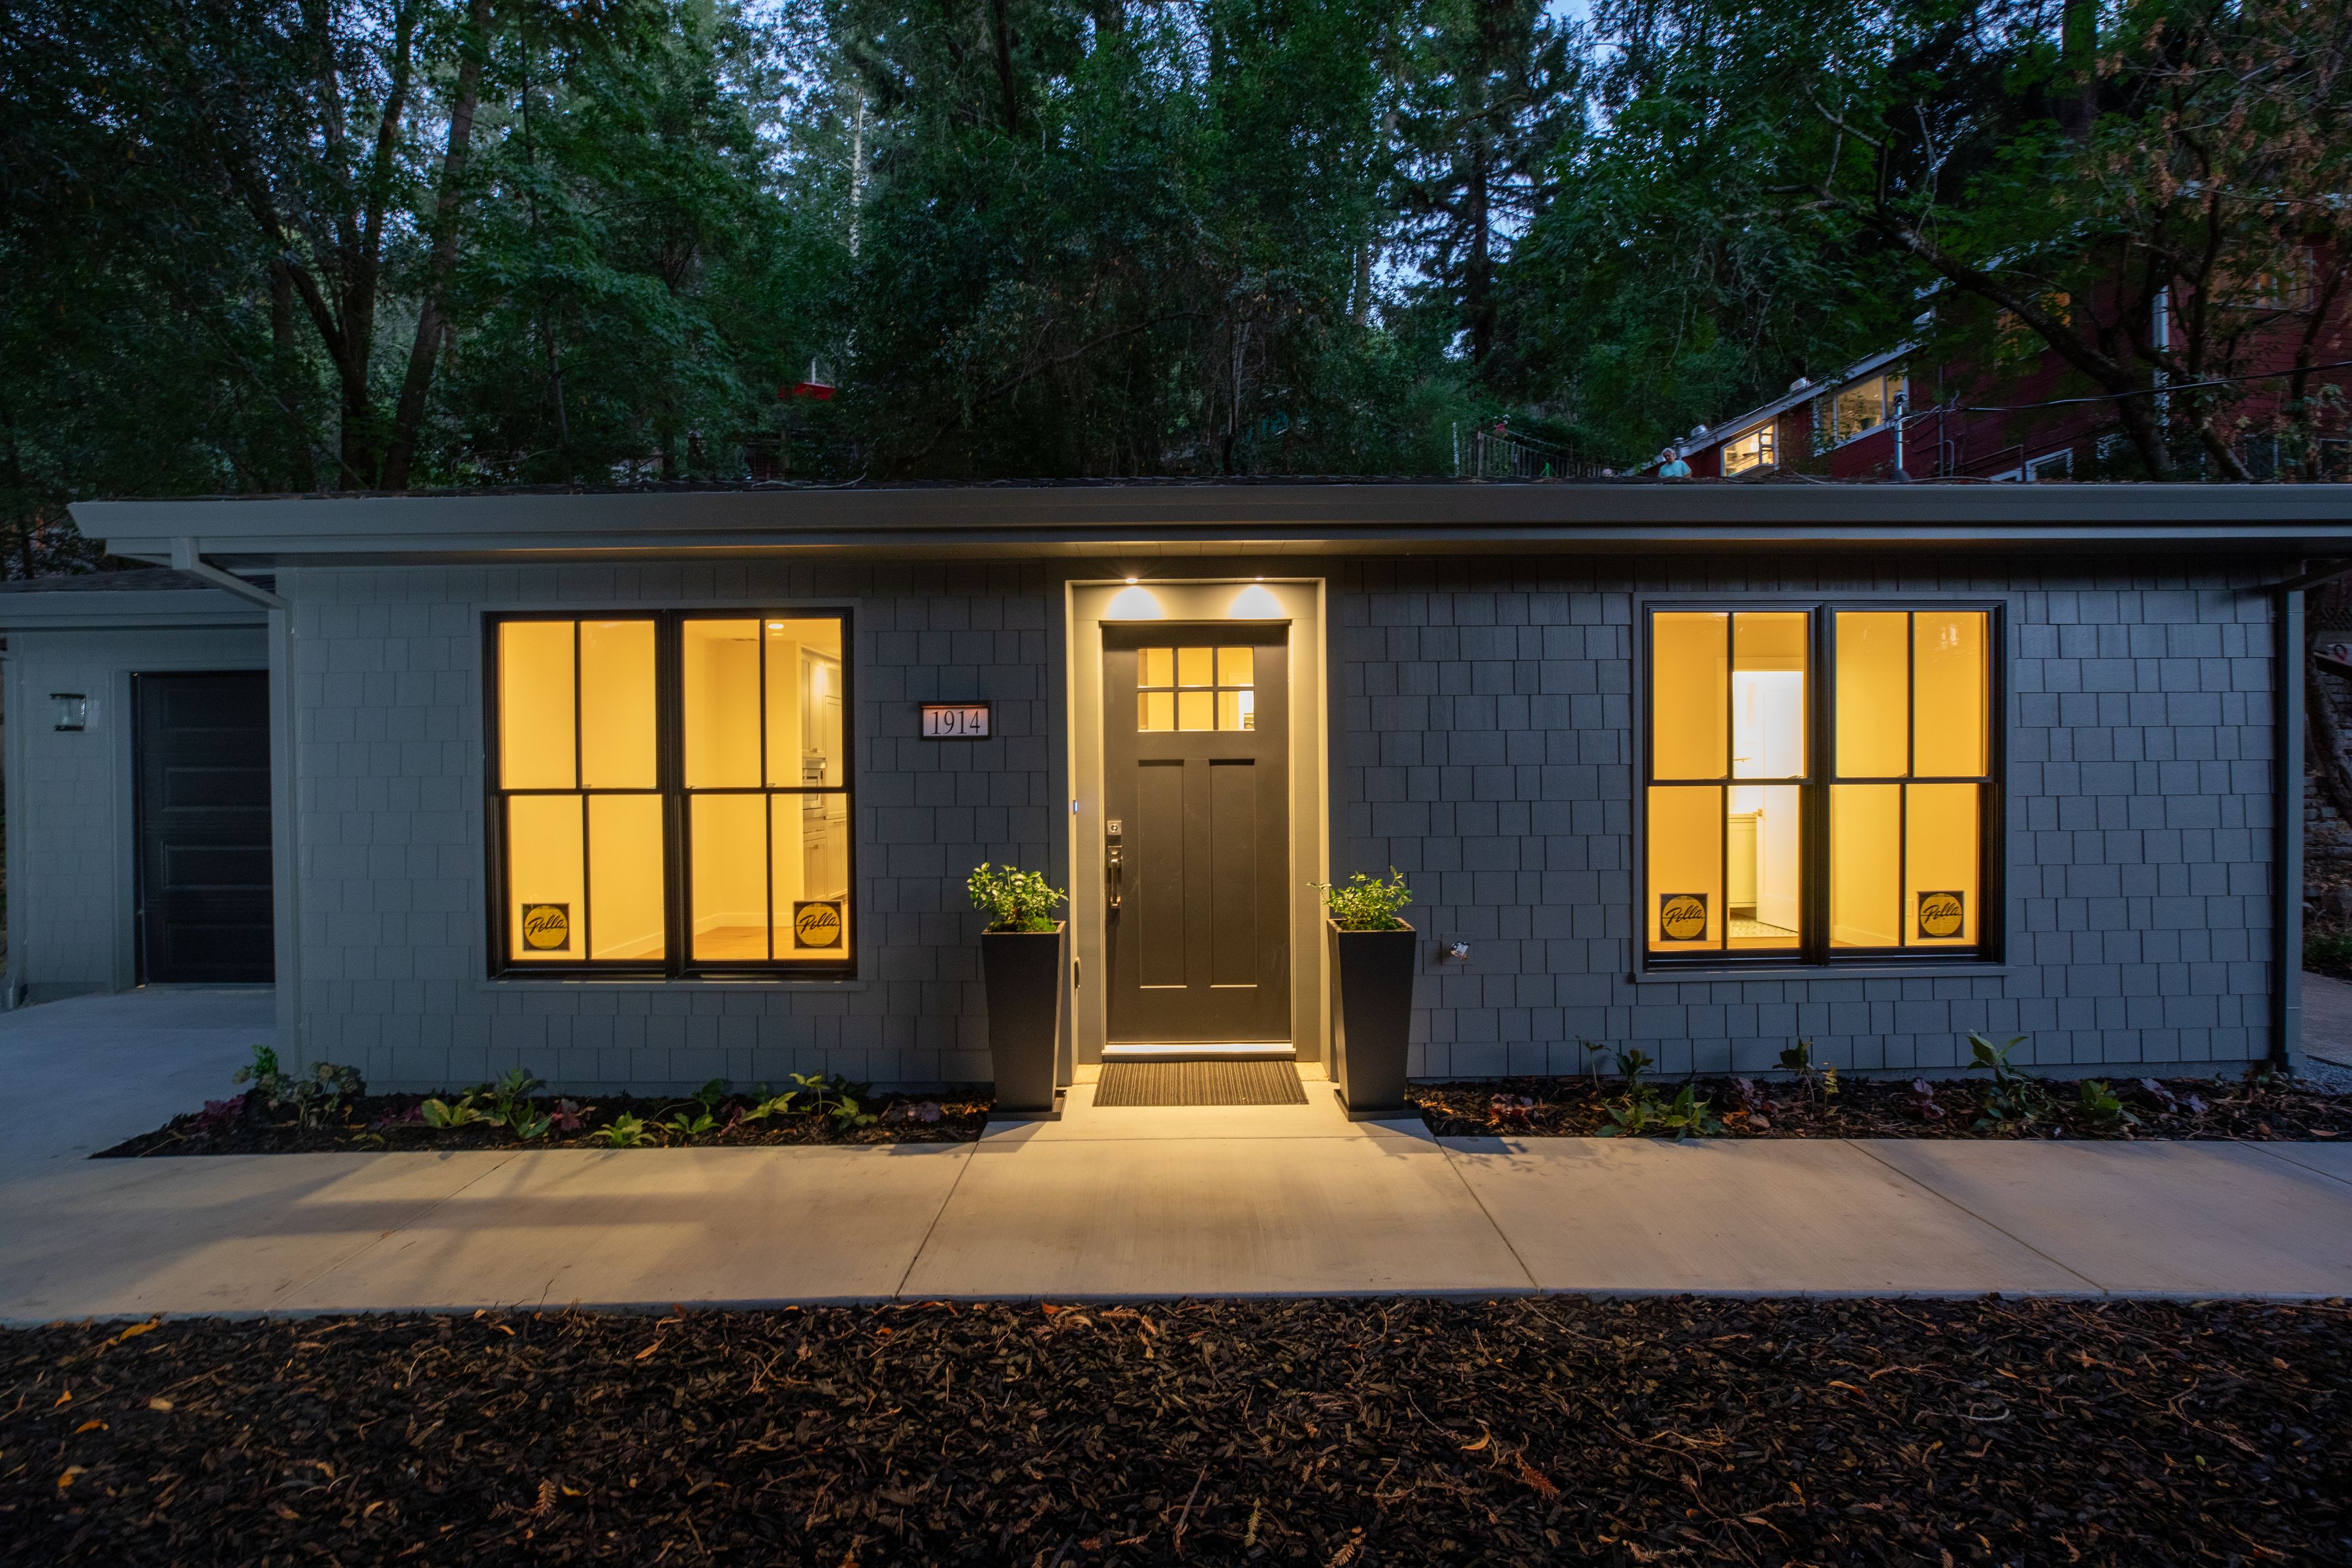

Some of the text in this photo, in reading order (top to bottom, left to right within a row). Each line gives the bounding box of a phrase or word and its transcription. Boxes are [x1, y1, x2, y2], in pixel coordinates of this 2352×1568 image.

[931, 710, 980, 734] 1914
[799, 912, 838, 935] Pella
[1665, 904, 1705, 926] Pella
[1923, 902, 1960, 924] Pella
[528, 914, 565, 937] Pella
